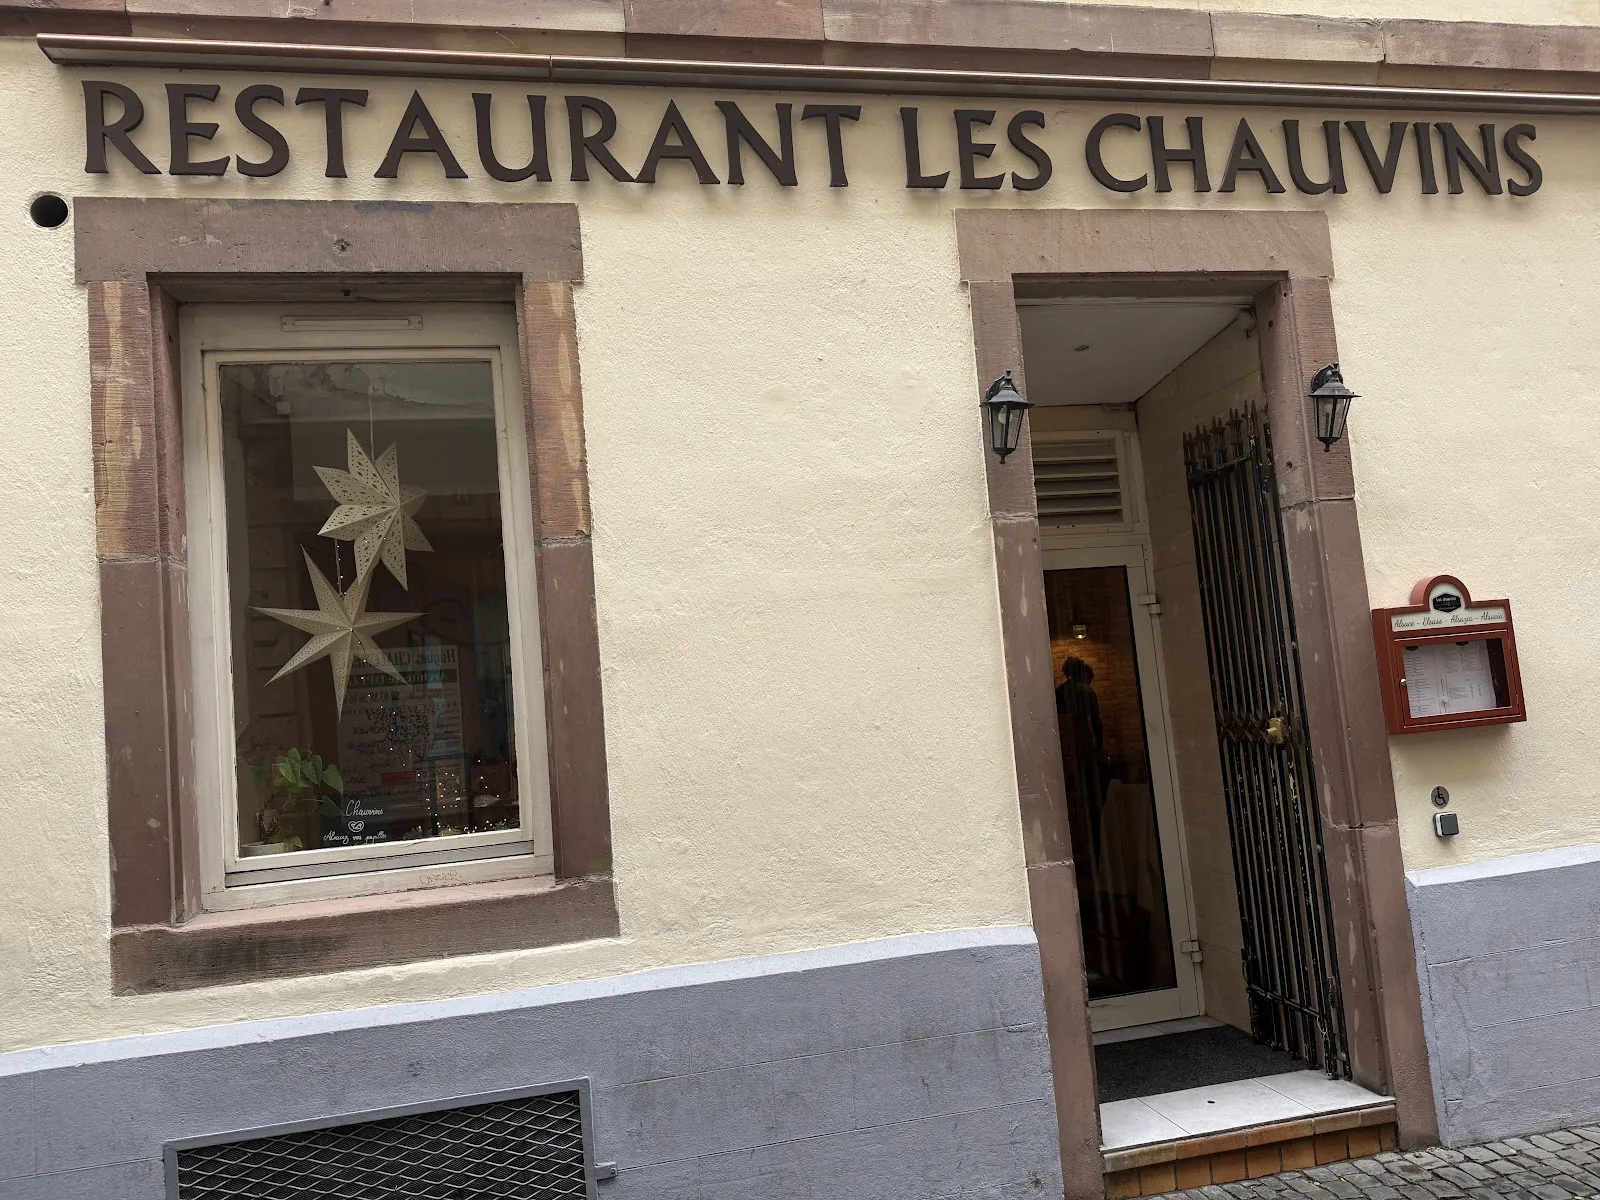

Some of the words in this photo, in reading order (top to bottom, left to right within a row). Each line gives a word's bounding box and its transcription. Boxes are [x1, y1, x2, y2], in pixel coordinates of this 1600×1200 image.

[81, 80, 862, 188] RESTAURANT
[900, 106, 1053, 191] LES
[1085, 113, 1543, 196] CHAUVINS
[1394, 619, 1415, 629] Alsace
